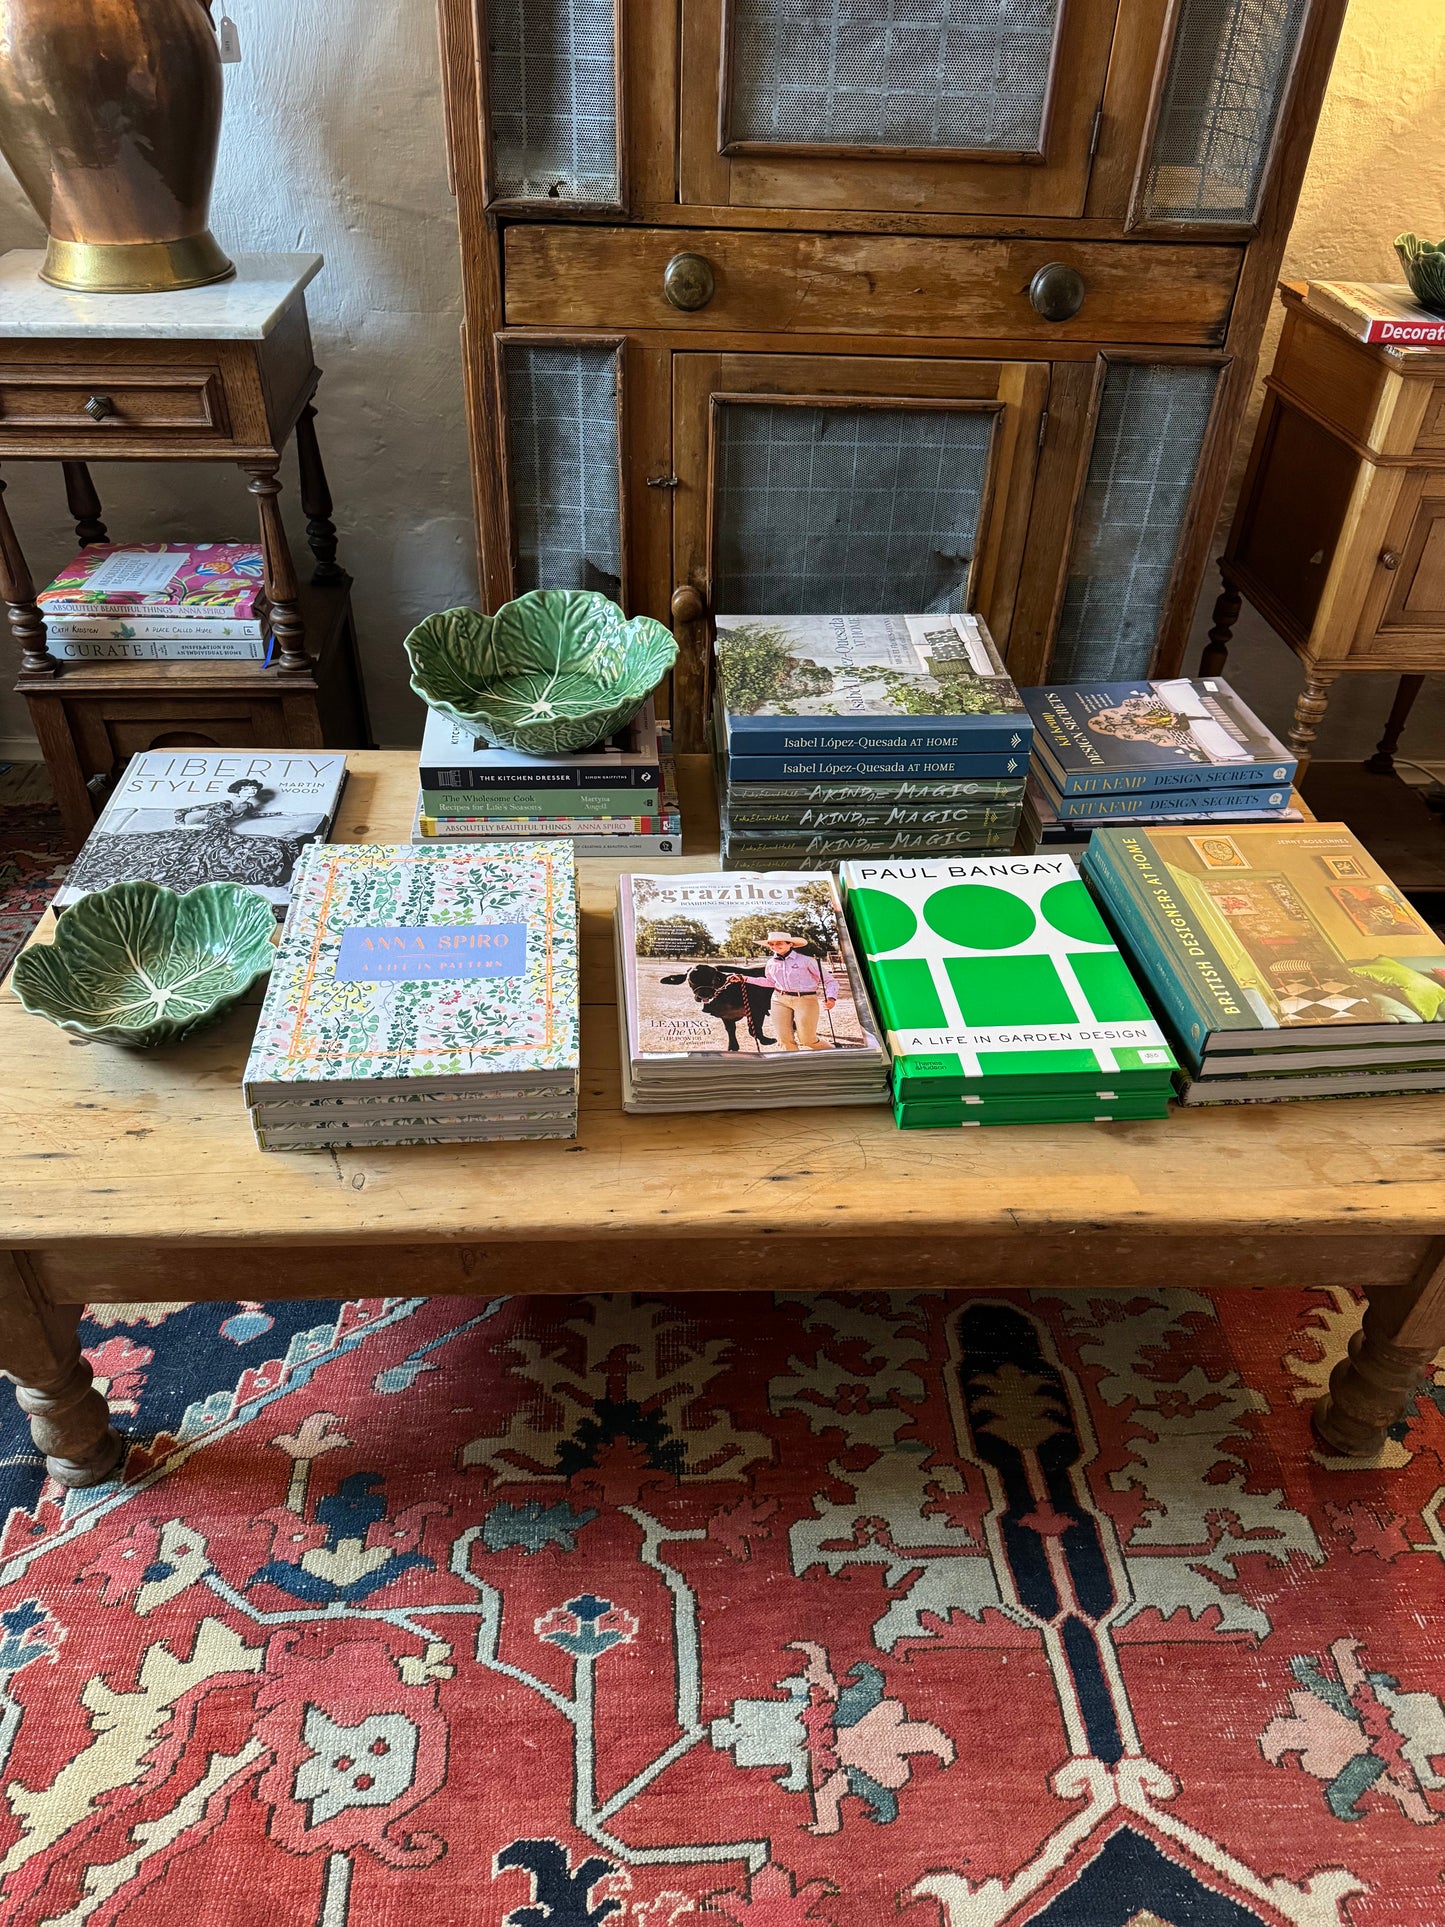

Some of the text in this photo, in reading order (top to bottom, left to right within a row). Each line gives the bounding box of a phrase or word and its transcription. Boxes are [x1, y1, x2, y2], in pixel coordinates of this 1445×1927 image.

[1381, 323, 1445, 341] Decorat
[53, 604, 226, 615] ABSOLUTELY BEAUTIFUL THINGS ANNA SPIRO
[64, 644, 144, 657] CURATE
[1045, 692, 1081, 731] SECRETS
[783, 736, 958, 750] Isabel López-Quesada AT HOME
[1071, 732, 1105, 765] DESIGN
[136, 758, 335, 778] LIBERTY
[782, 762, 956, 775] Isabel López-Quesada AT HOME
[127, 780, 224, 793] STYLE
[1072, 770, 1264, 792] KIT KEMP DESIGN SECRETS
[442, 794, 535, 802] The Wholesome Cook
[808, 785, 823, 801] A
[823, 787, 876, 803] KIND
[867, 792, 890, 801] OF
[894, 782, 979, 800] MAGIC
[439, 803, 470, 812] Recipes
[472, 803, 484, 811] for
[486, 803, 508, 811] Life's
[1069, 795, 1260, 815] KIT KEMP DESIGN SECRETS
[799, 809, 813, 826] A
[813, 811, 863, 828] KIND
[857, 817, 880, 827] OF
[884, 807, 969, 826] MAGIC
[445, 824, 494, 832] ABSOLUTELY
[805, 836, 820, 853] A
[819, 838, 869, 855] KIND
[863, 842, 885, 852] OF
[889, 831, 971, 850] MAGIC
[1122, 838, 1152, 870] HOME
[799, 856, 811, 871] A
[861, 862, 1063, 880] PAUL BANGAY
[1143, 873, 1162, 885] AT
[660, 884, 800, 903] graziher
[1153, 889, 1205, 956] DESIGNERS
[360, 933, 510, 951] ANNA SPIRO
[377, 962, 407, 971] LIFE
[417, 962, 431, 970] IN
[440, 960, 503, 970] PATTERN
[1195, 961, 1241, 1014] BRITISH
[650, 1020, 709, 1028] LEADING
[667, 1027, 712, 1036] the WAY
[911, 1029, 1148, 1046] A LIFE IN GARDEN DESIGN
